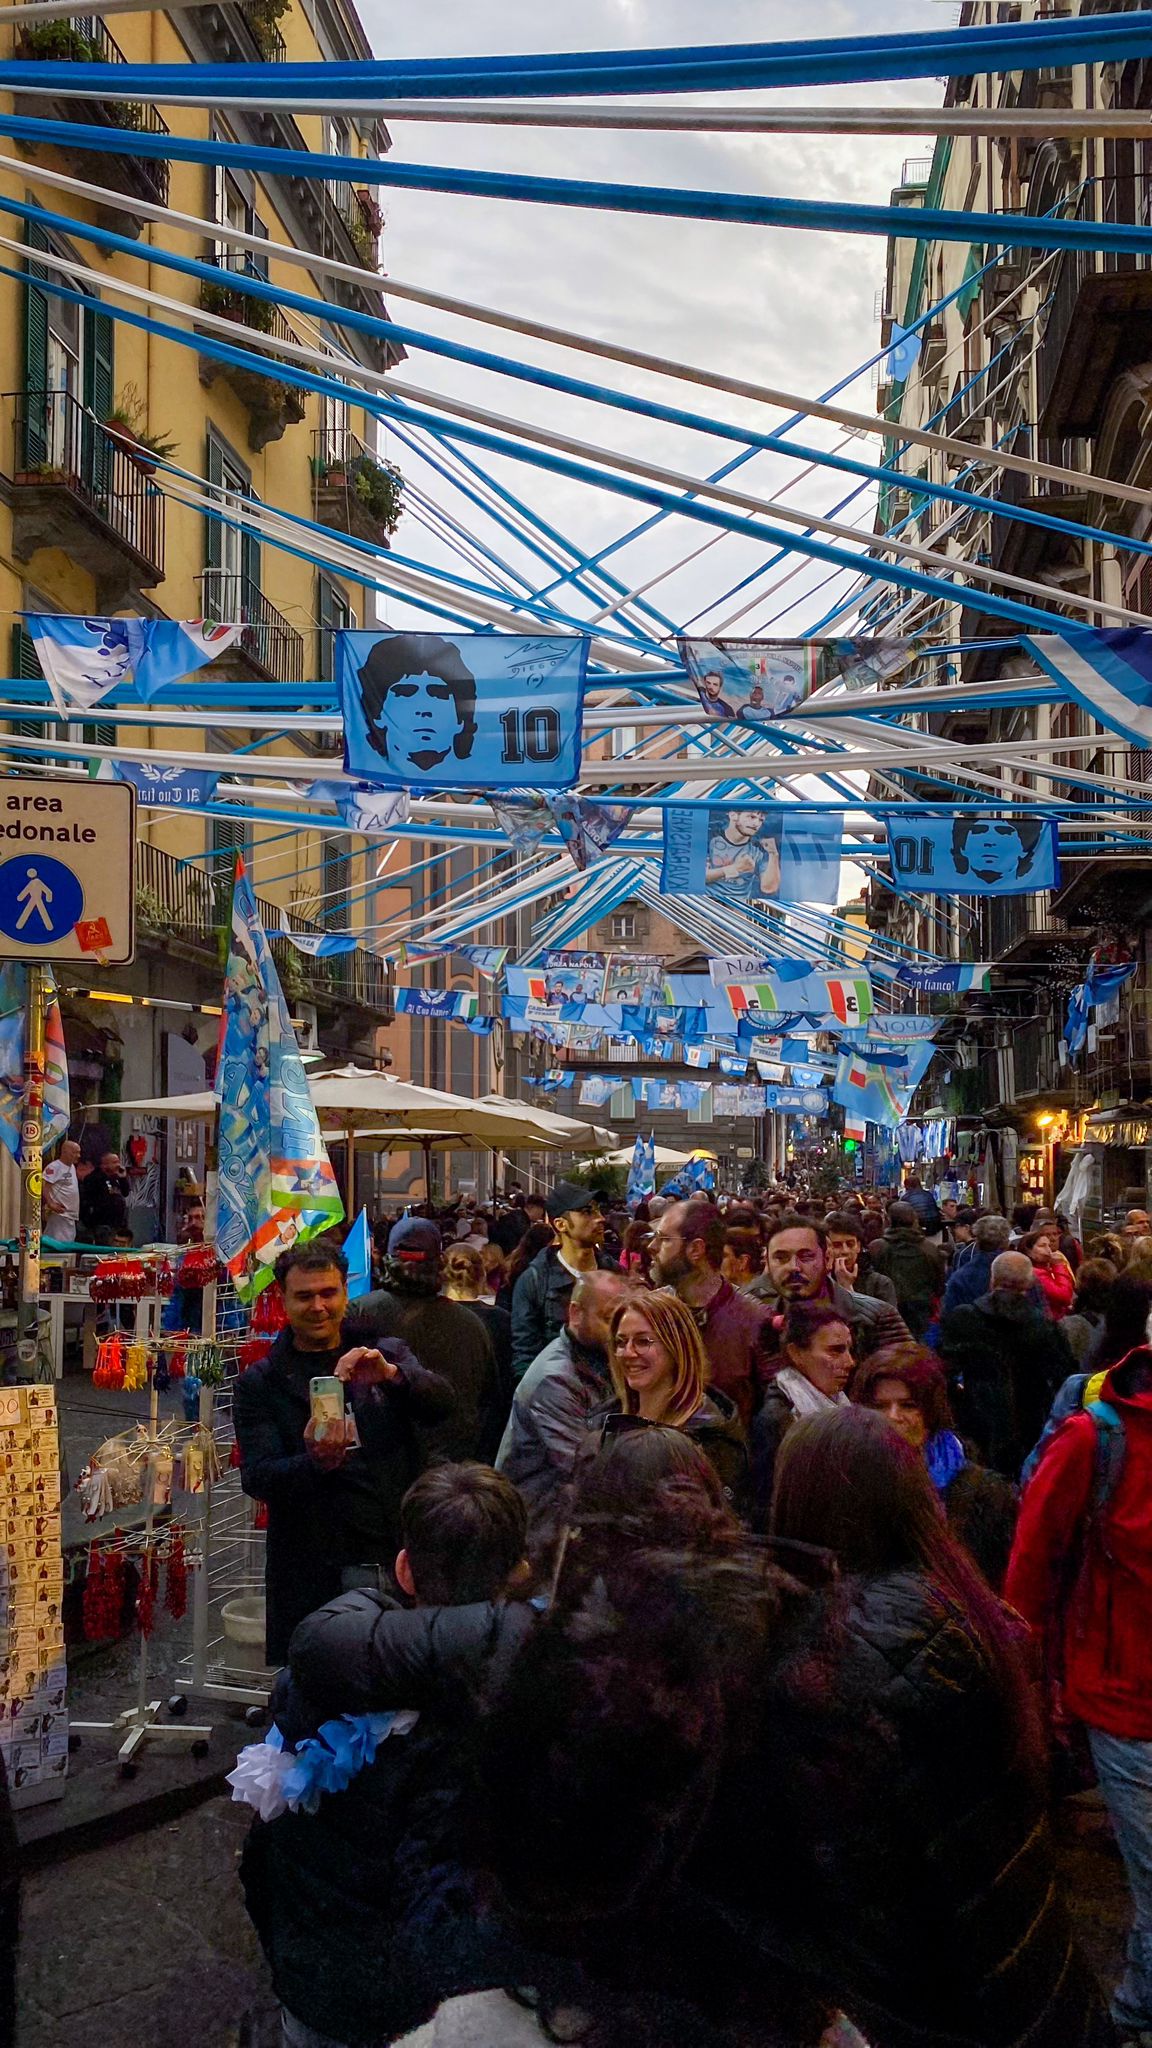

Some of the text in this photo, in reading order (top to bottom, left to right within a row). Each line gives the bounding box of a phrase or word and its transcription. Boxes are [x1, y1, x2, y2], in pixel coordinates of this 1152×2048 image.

[500, 705, 562, 764] 10
[6, 795, 63, 813] area
[924, 979, 955, 992] fianco!
[406, 1003, 415, 1014] Al
[415, 1005, 430, 1015] Tuo
[769, 1091, 778, 1102] 9
[25, 1126, 36, 1135] 18
